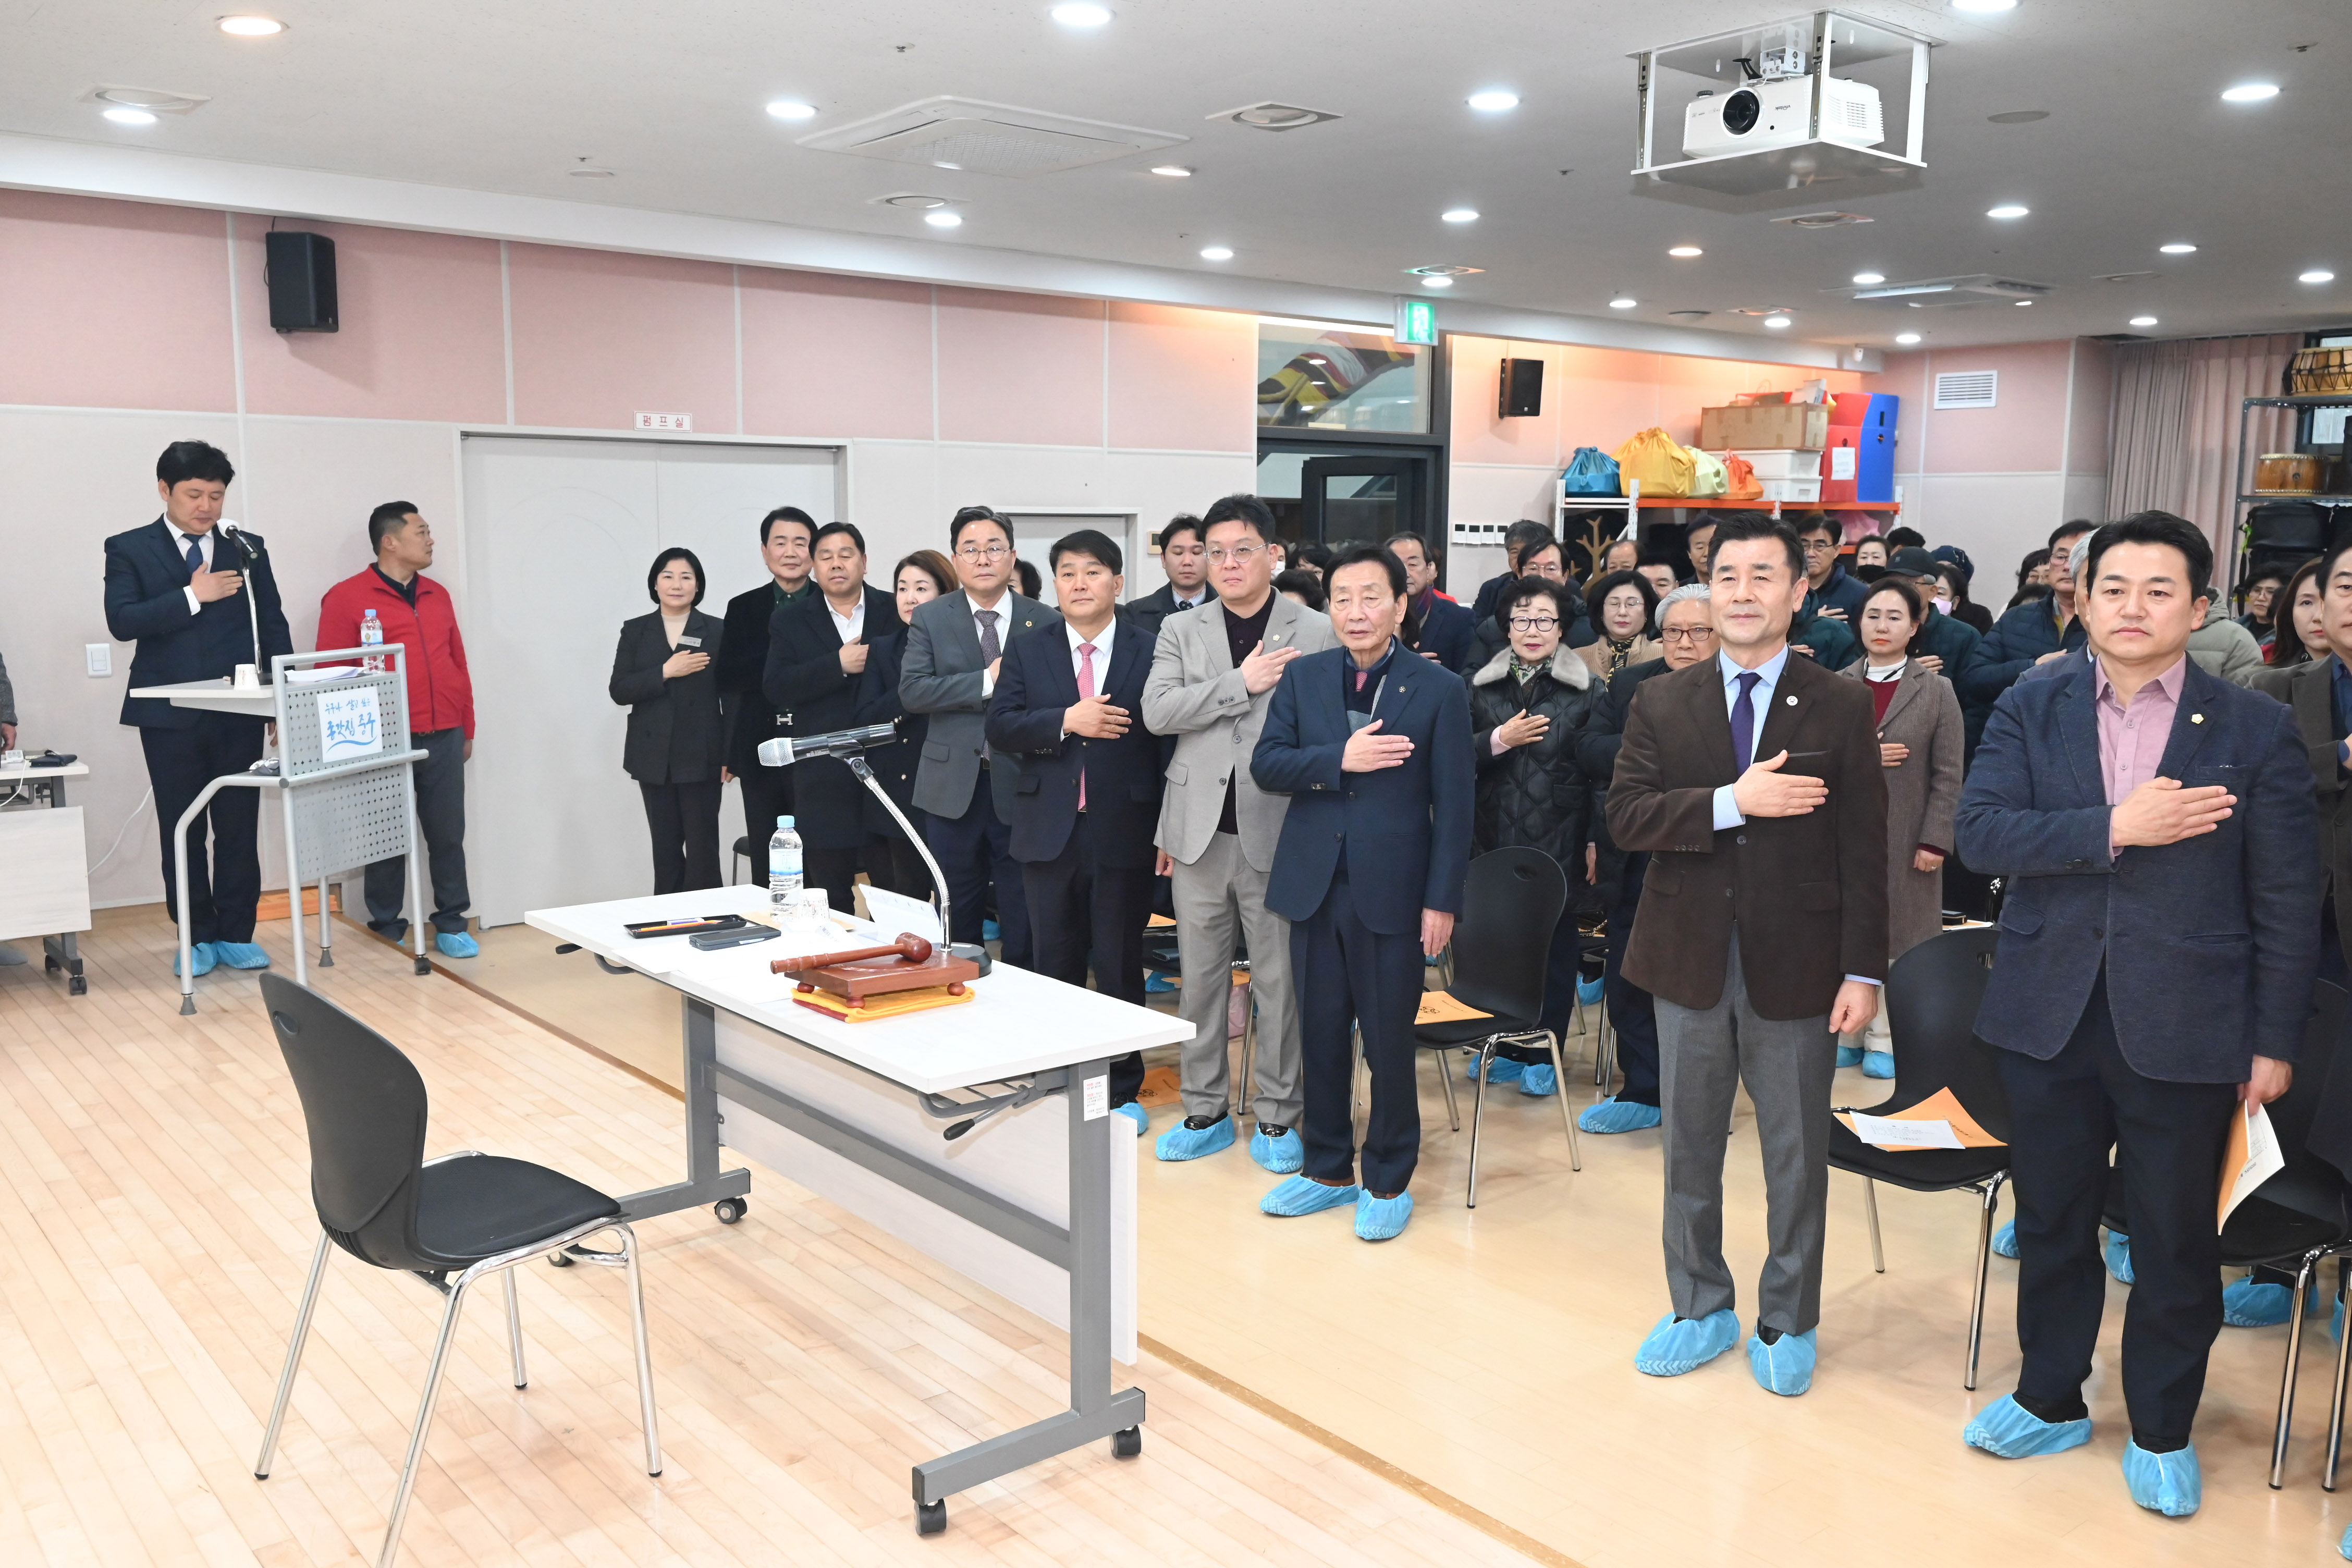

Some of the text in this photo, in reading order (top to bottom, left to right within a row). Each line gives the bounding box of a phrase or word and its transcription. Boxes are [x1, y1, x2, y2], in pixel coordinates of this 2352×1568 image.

[325, 697, 371, 715] 누구나 살고 싶은
[326, 712, 376, 741] 종갓집 중구
